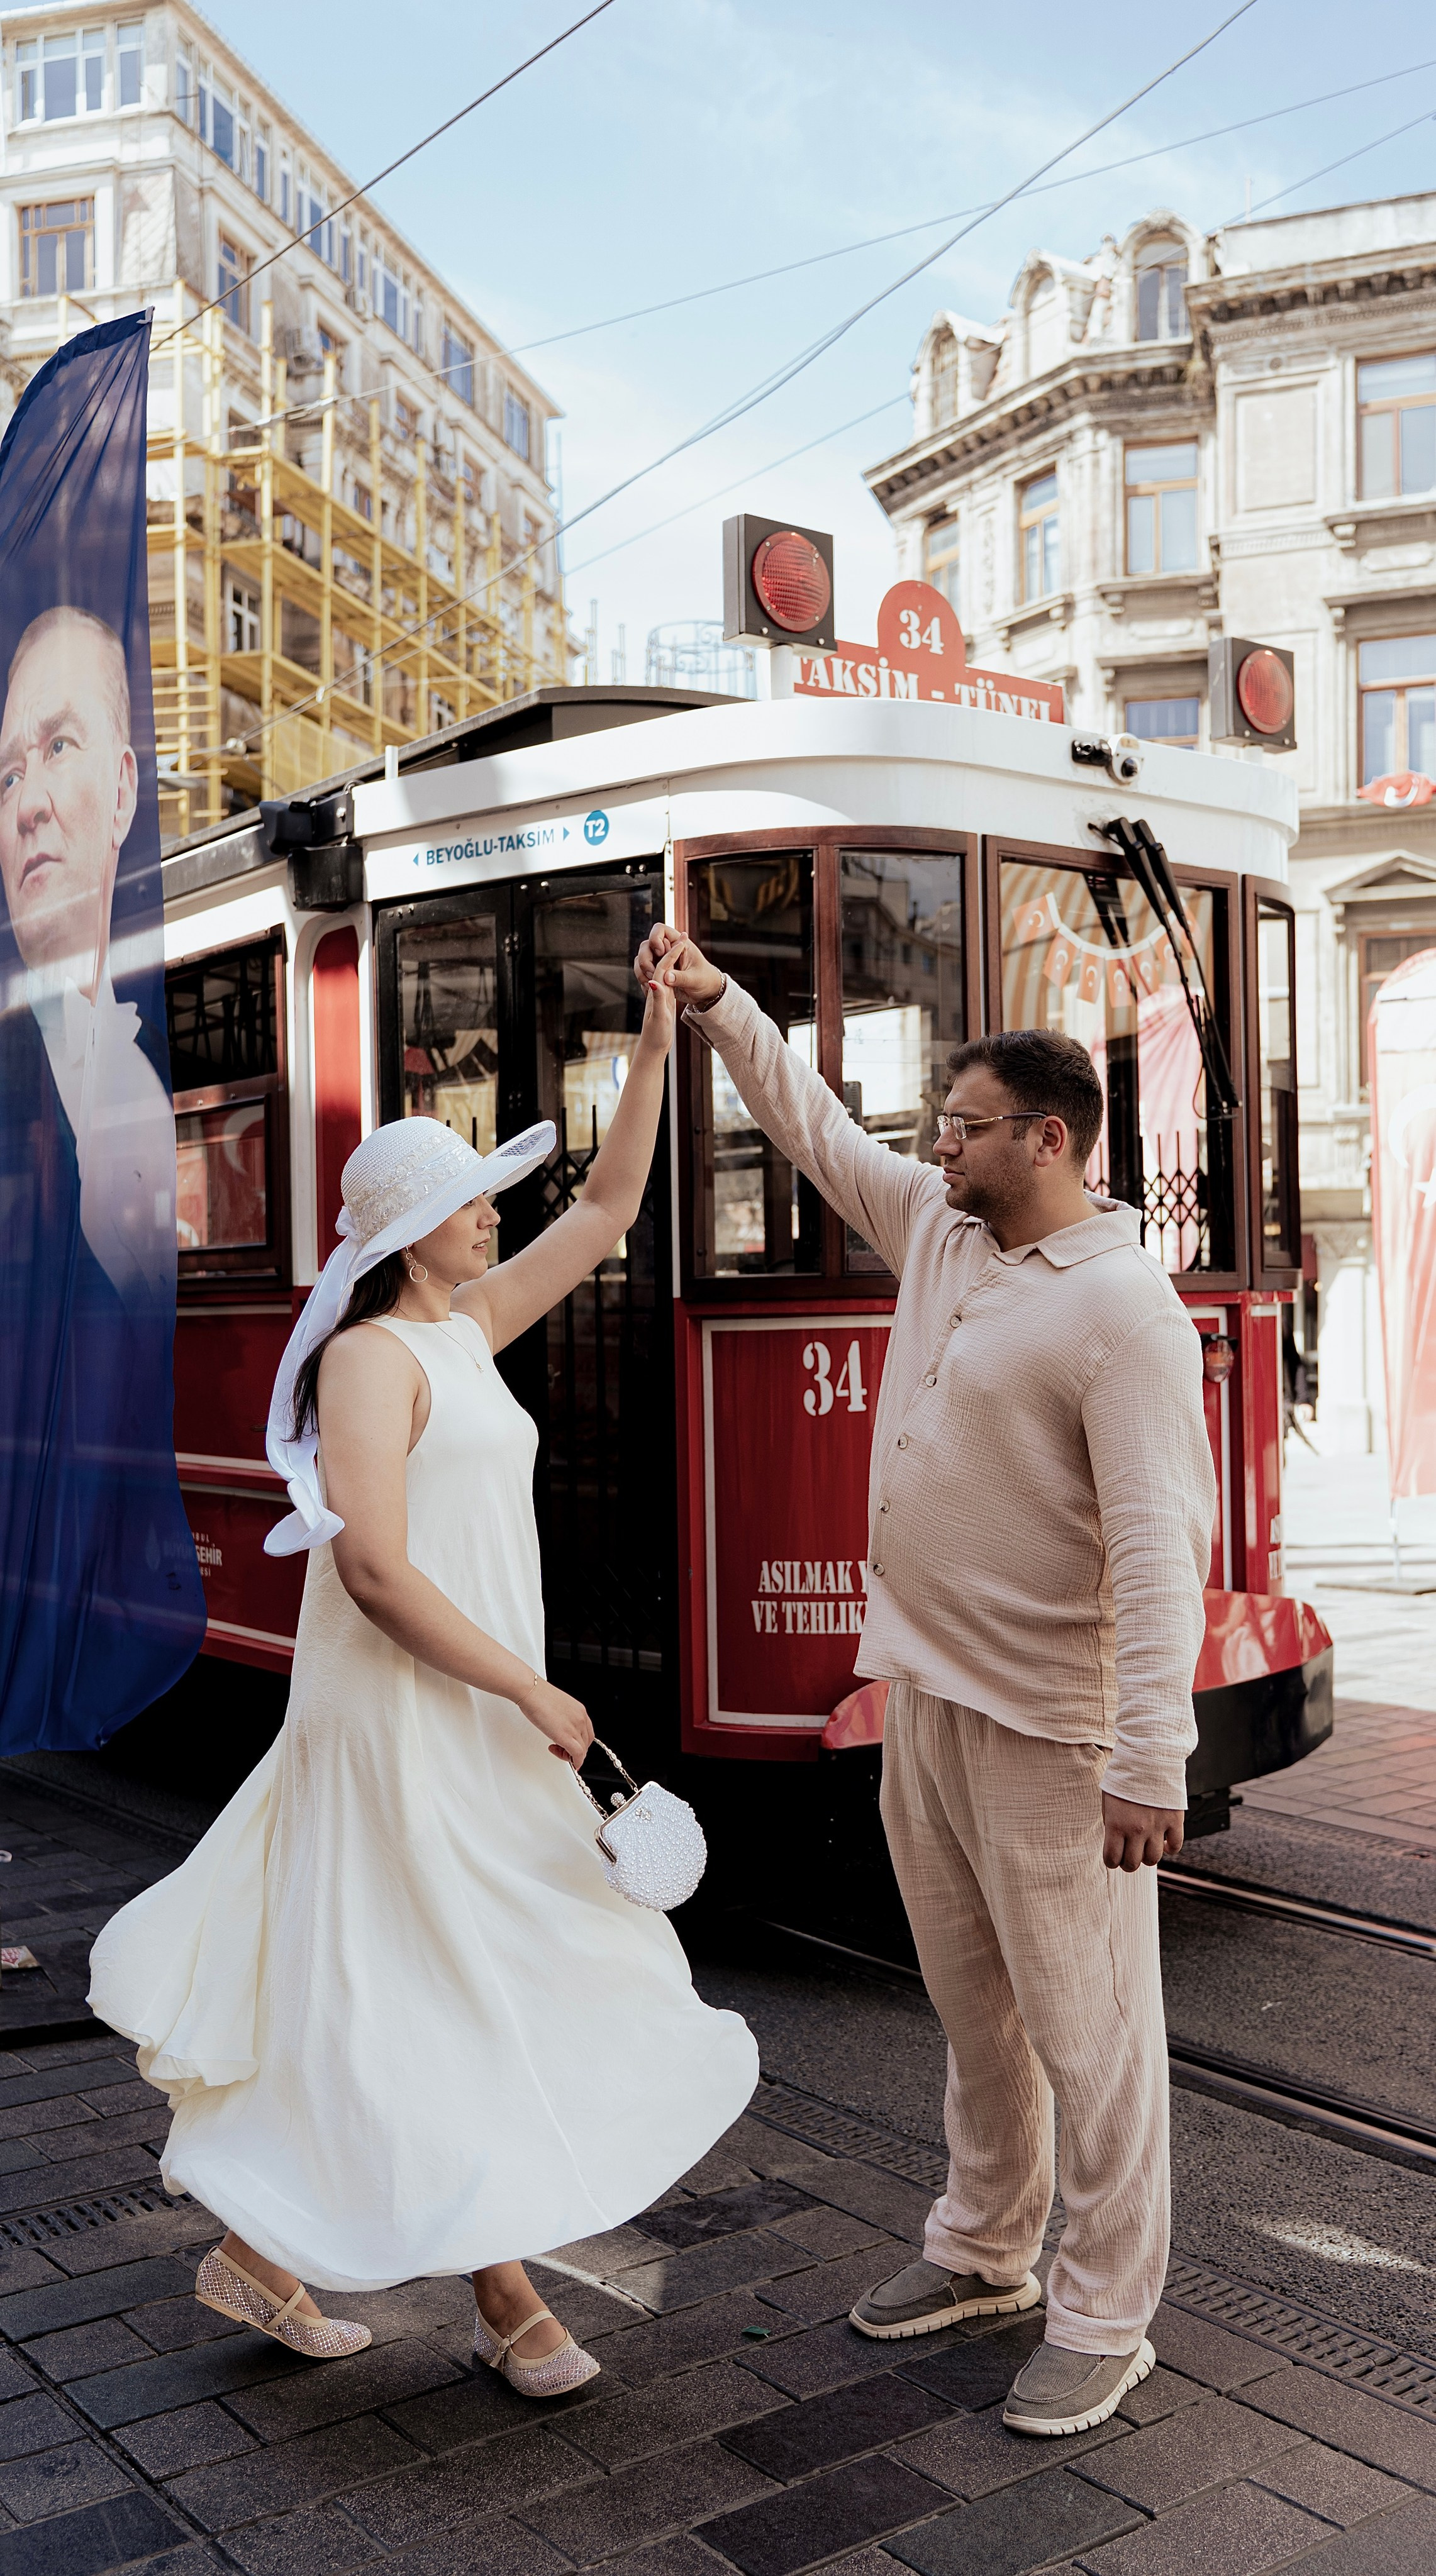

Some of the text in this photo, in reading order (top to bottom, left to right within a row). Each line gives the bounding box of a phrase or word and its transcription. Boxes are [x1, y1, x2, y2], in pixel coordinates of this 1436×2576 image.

[899, 609, 944, 655] 34
[426, 818, 606, 865] BEYOĞLU-TAKSİM T2
[803, 1340, 867, 1417] 34
[758, 1560, 854, 1594] ASILMAK
[751, 1600, 778, 1633] VE
